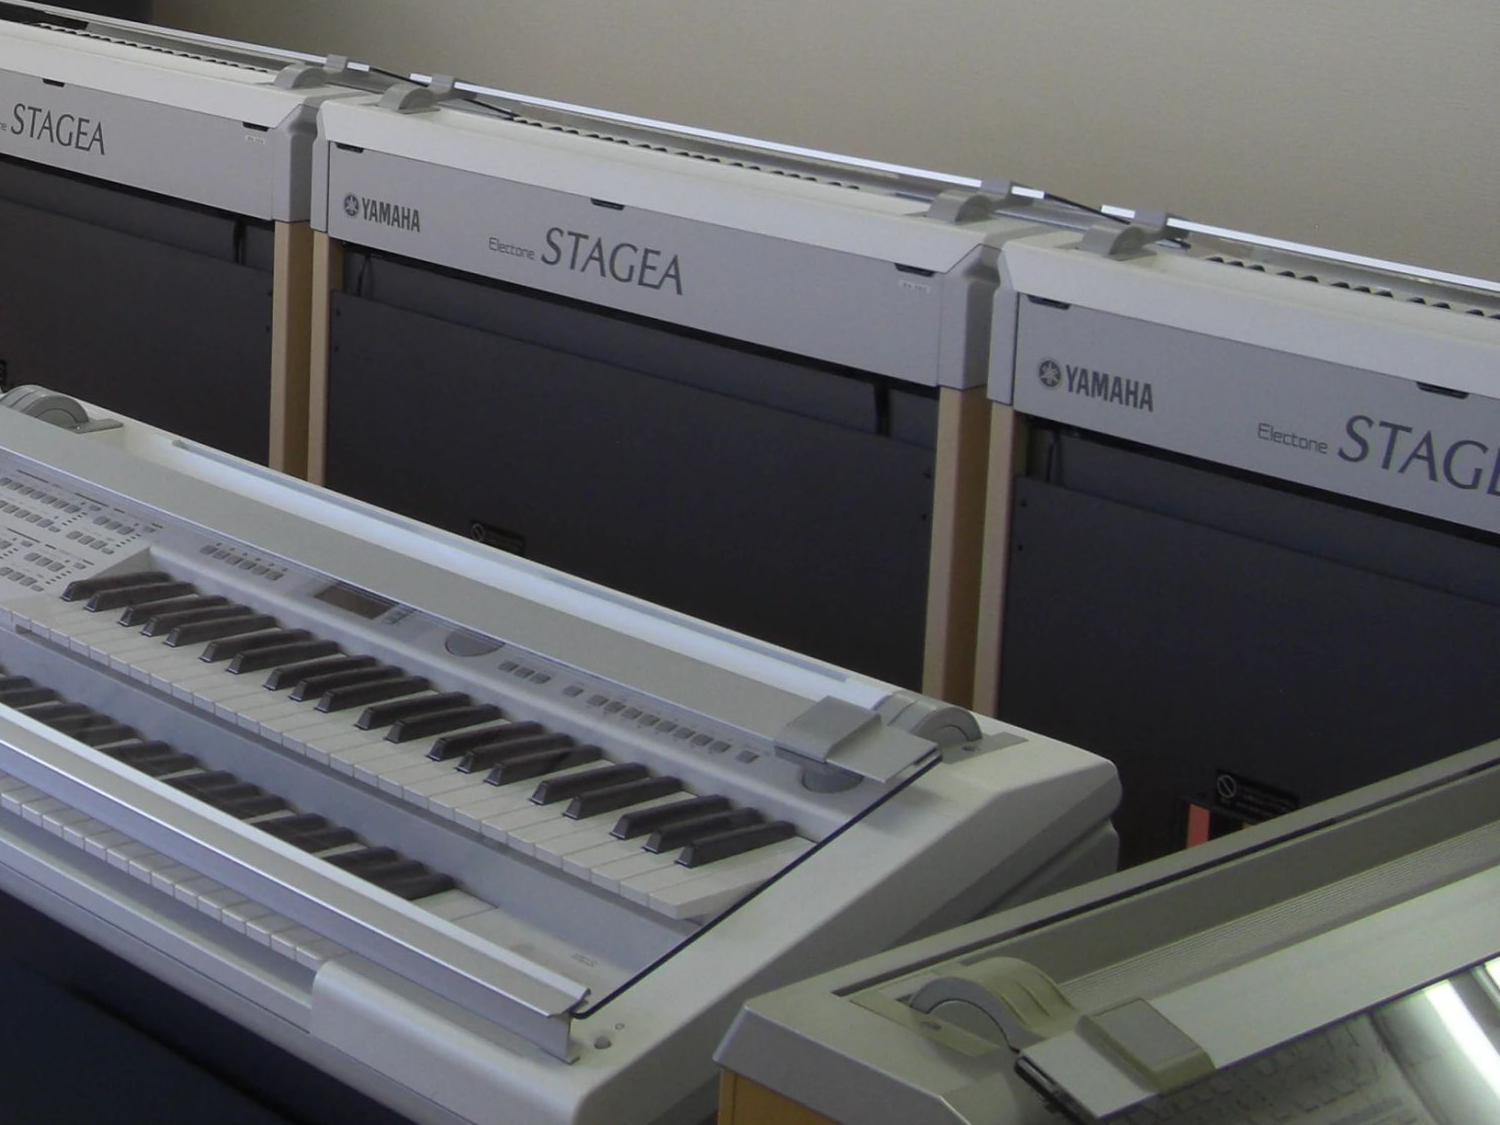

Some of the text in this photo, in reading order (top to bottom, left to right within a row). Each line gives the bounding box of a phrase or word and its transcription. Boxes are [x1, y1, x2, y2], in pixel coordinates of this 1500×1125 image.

[10, 103, 106, 156] STAGEA
[361, 197, 421, 233] YAMAHA
[488, 227, 683, 296] Electone STAGEA
[1065, 364, 1154, 413] YAMAHA
[1257, 422, 1328, 455] Electone
